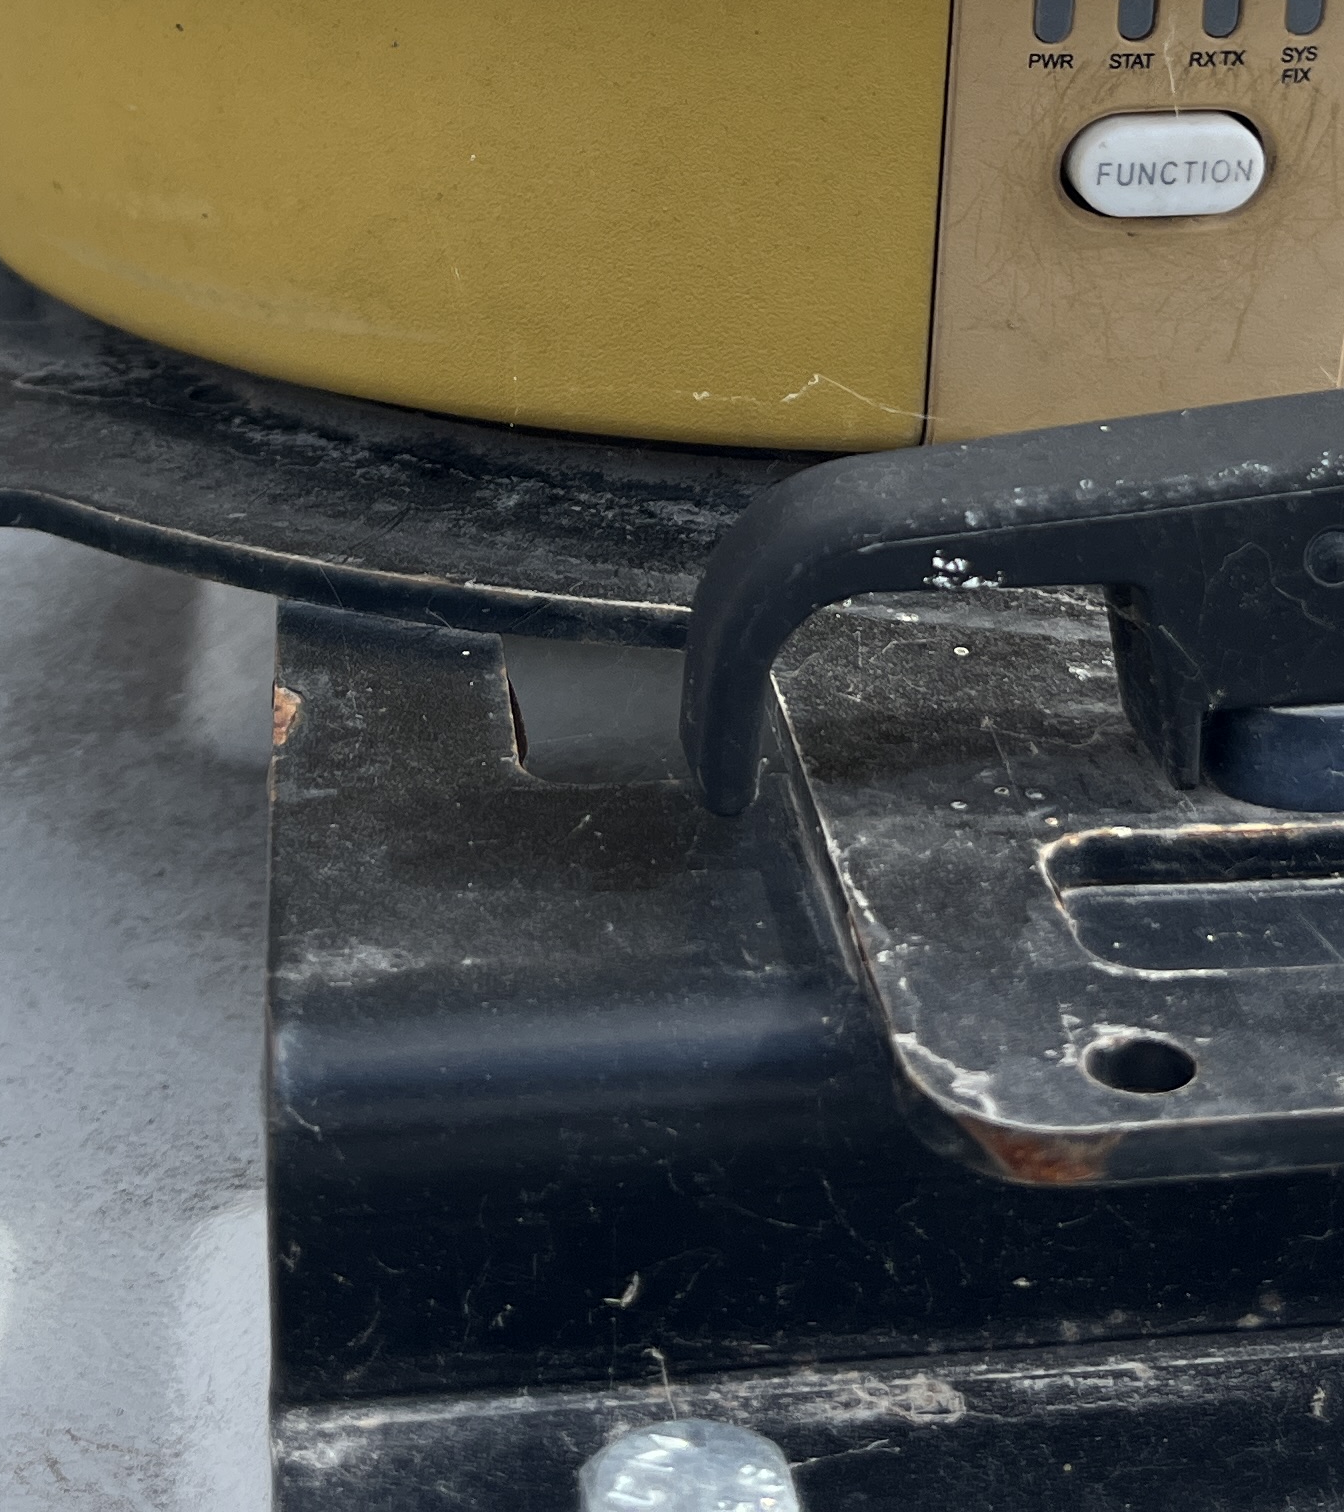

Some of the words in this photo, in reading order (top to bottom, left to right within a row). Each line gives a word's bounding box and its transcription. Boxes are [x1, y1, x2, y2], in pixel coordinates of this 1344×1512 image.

[1028, 53, 1074, 69] PWR
[1109, 53, 1154, 69] STAT
[1281, 47, 1317, 64] SYS
[1281, 67, 1311, 83] FIX
[1097, 160, 1253, 186] FUNCTION
